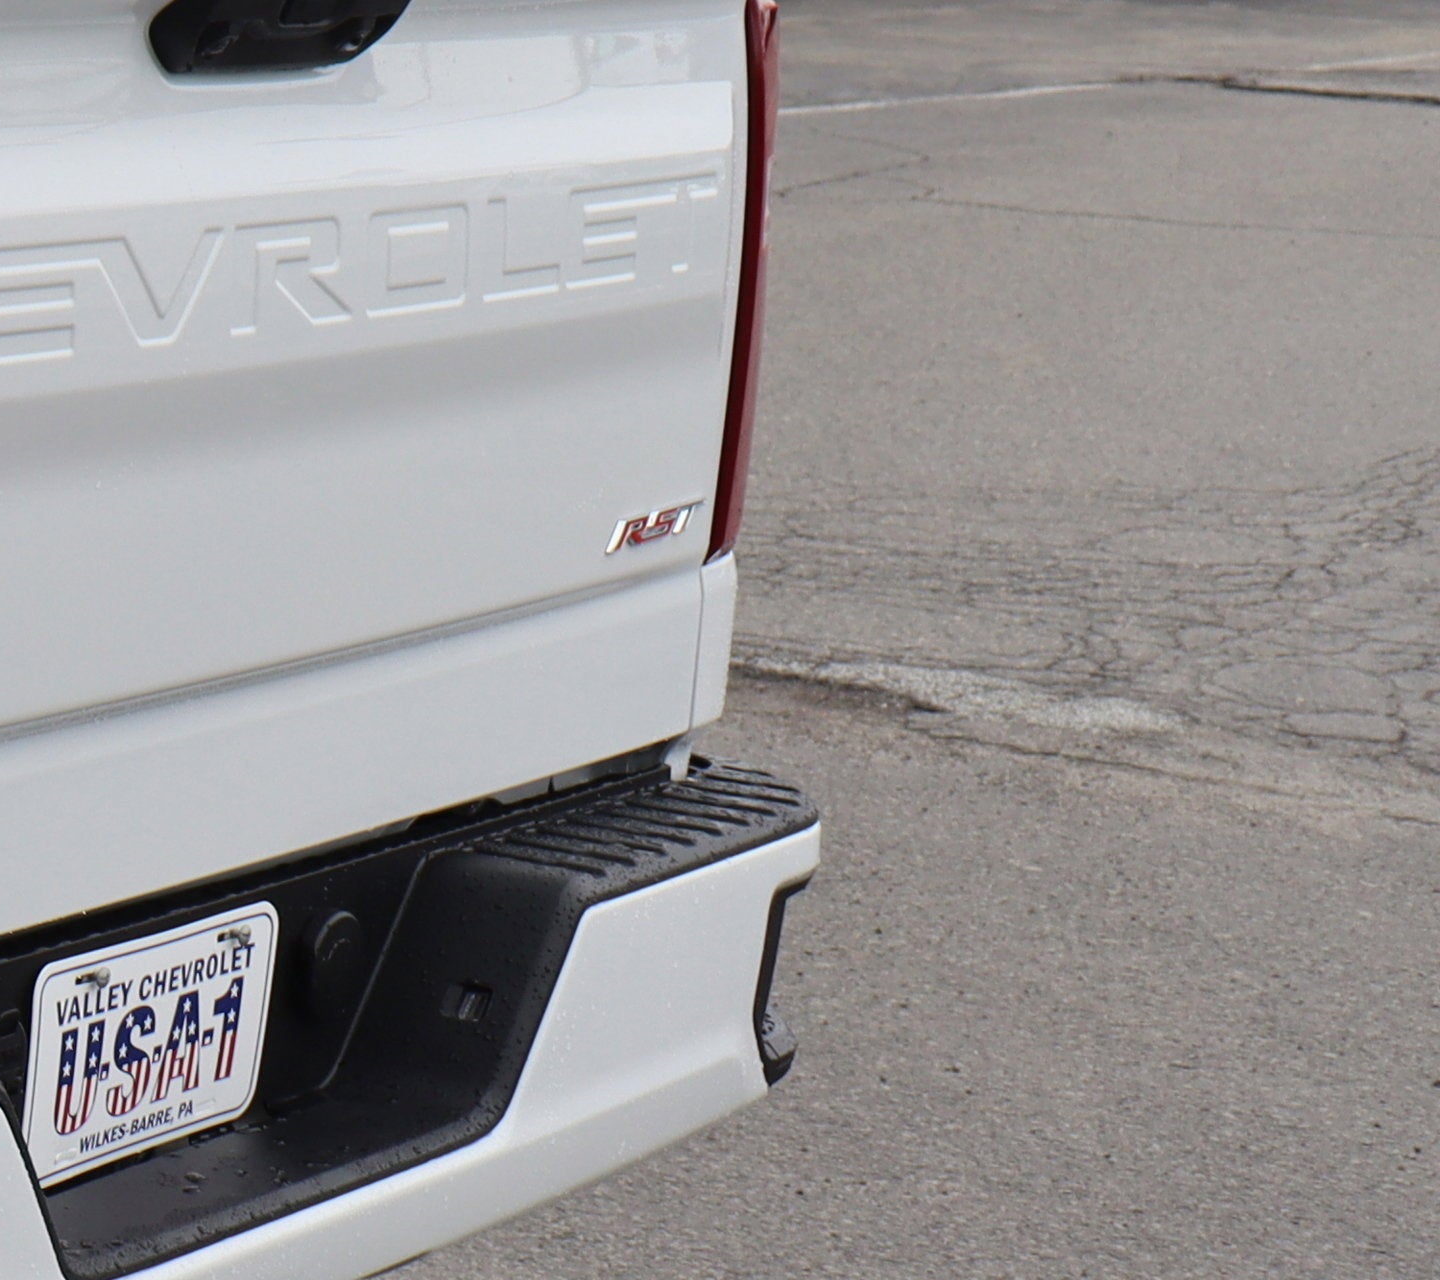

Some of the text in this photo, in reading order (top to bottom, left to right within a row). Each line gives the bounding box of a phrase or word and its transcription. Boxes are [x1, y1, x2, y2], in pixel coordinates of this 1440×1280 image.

[605, 498, 705, 555] RST
[56, 943, 256, 1026] VALLEY CHEVROLET
[177, 1099, 194, 1120] PA
